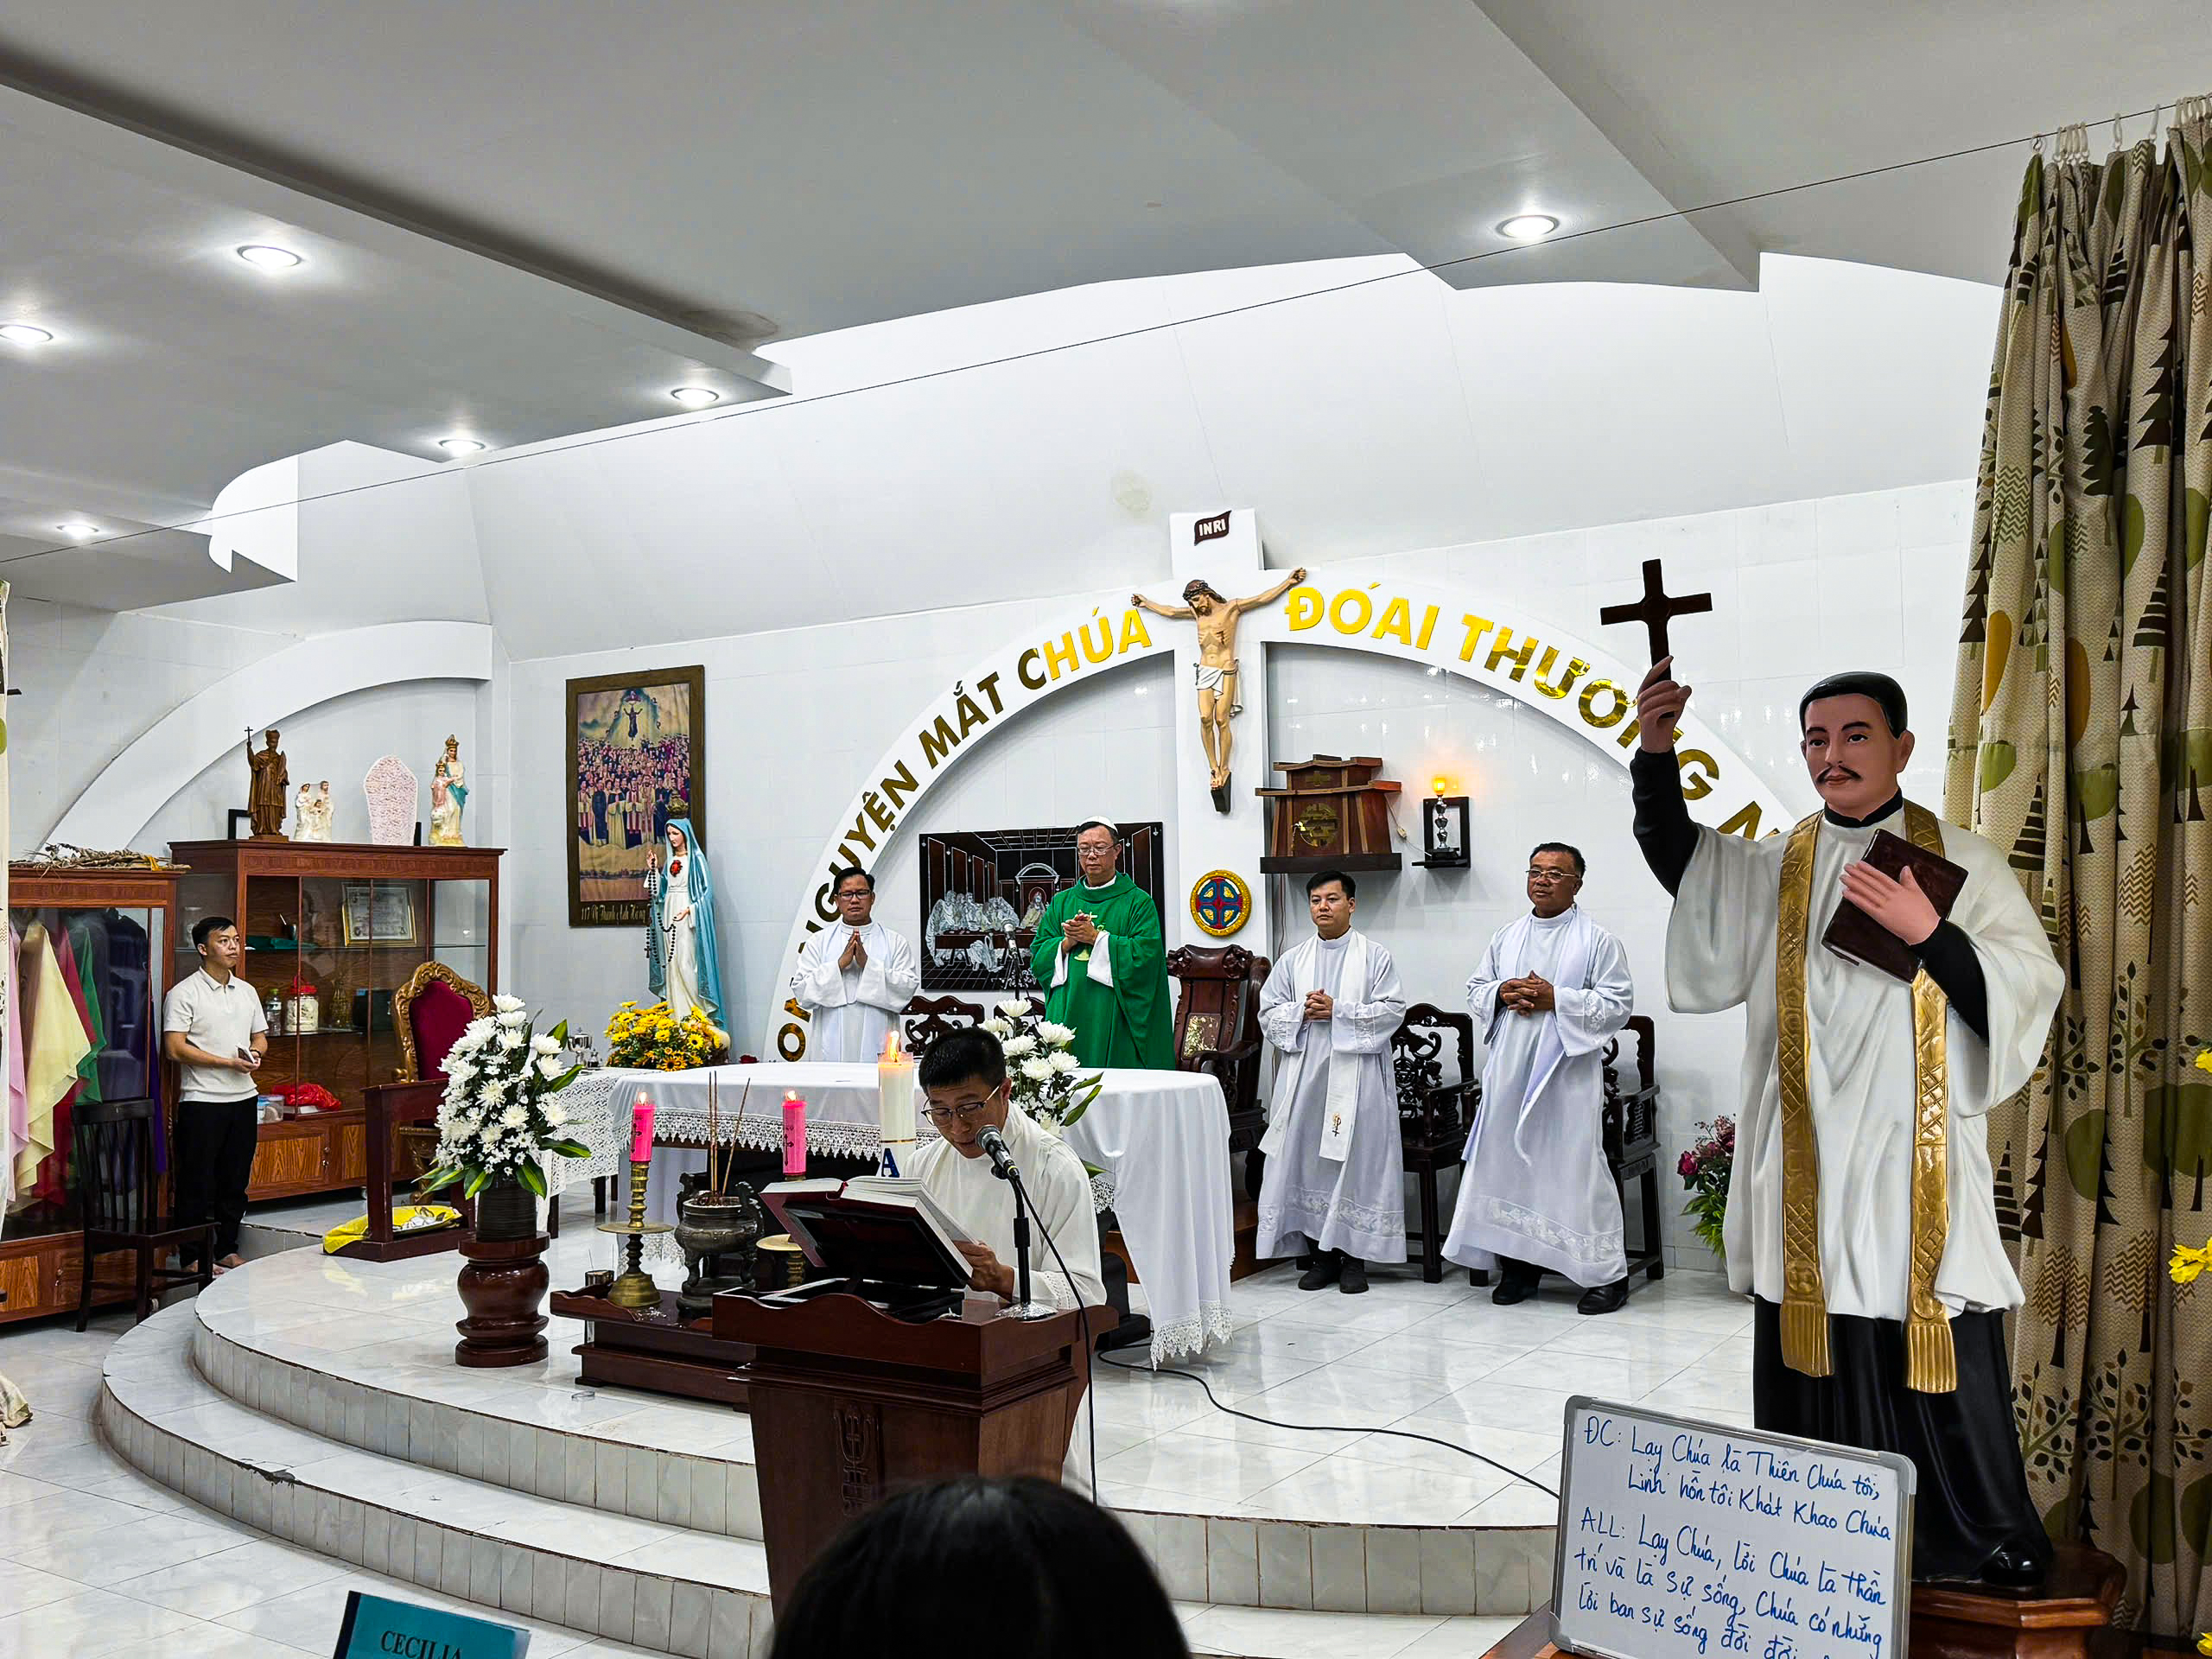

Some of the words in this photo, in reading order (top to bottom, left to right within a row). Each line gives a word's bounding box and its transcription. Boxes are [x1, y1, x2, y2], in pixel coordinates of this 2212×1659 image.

[1198, 518, 1226, 536] INRI
[918, 680, 1003, 769] MẮT
[1018, 607, 1152, 690] CHÚA
[1584, 1415, 1622, 1446] ĐC:
[1632, 1426, 1662, 1468] Lạy
[1672, 1434, 1710, 1466] Chúa
[1747, 1452, 1799, 1483] Thiên
[1807, 1464, 1847, 1490] Chúa
[1629, 1464, 1666, 1495] Linh
[1709, 1481, 1733, 1506] tôi
[1846, 1510, 1891, 1540] Chúa
[1581, 1507, 1624, 1539] ALL:
[1638, 1514, 1669, 1566] Lạy
[1676, 1525, 1721, 1570] Chúa,
[1770, 1552, 1808, 1585] Chúa
[381, 1630, 463, 1659] CECILIA
[1605, 1556, 1625, 1580] và
[1756, 1591, 1799, 1625] Chúa
[1809, 1606, 1830, 1632] có
[1832, 1611, 1882, 1659] những
[1610, 1592, 1635, 1619] ban
[1721, 1623, 1751, 1653] đời
